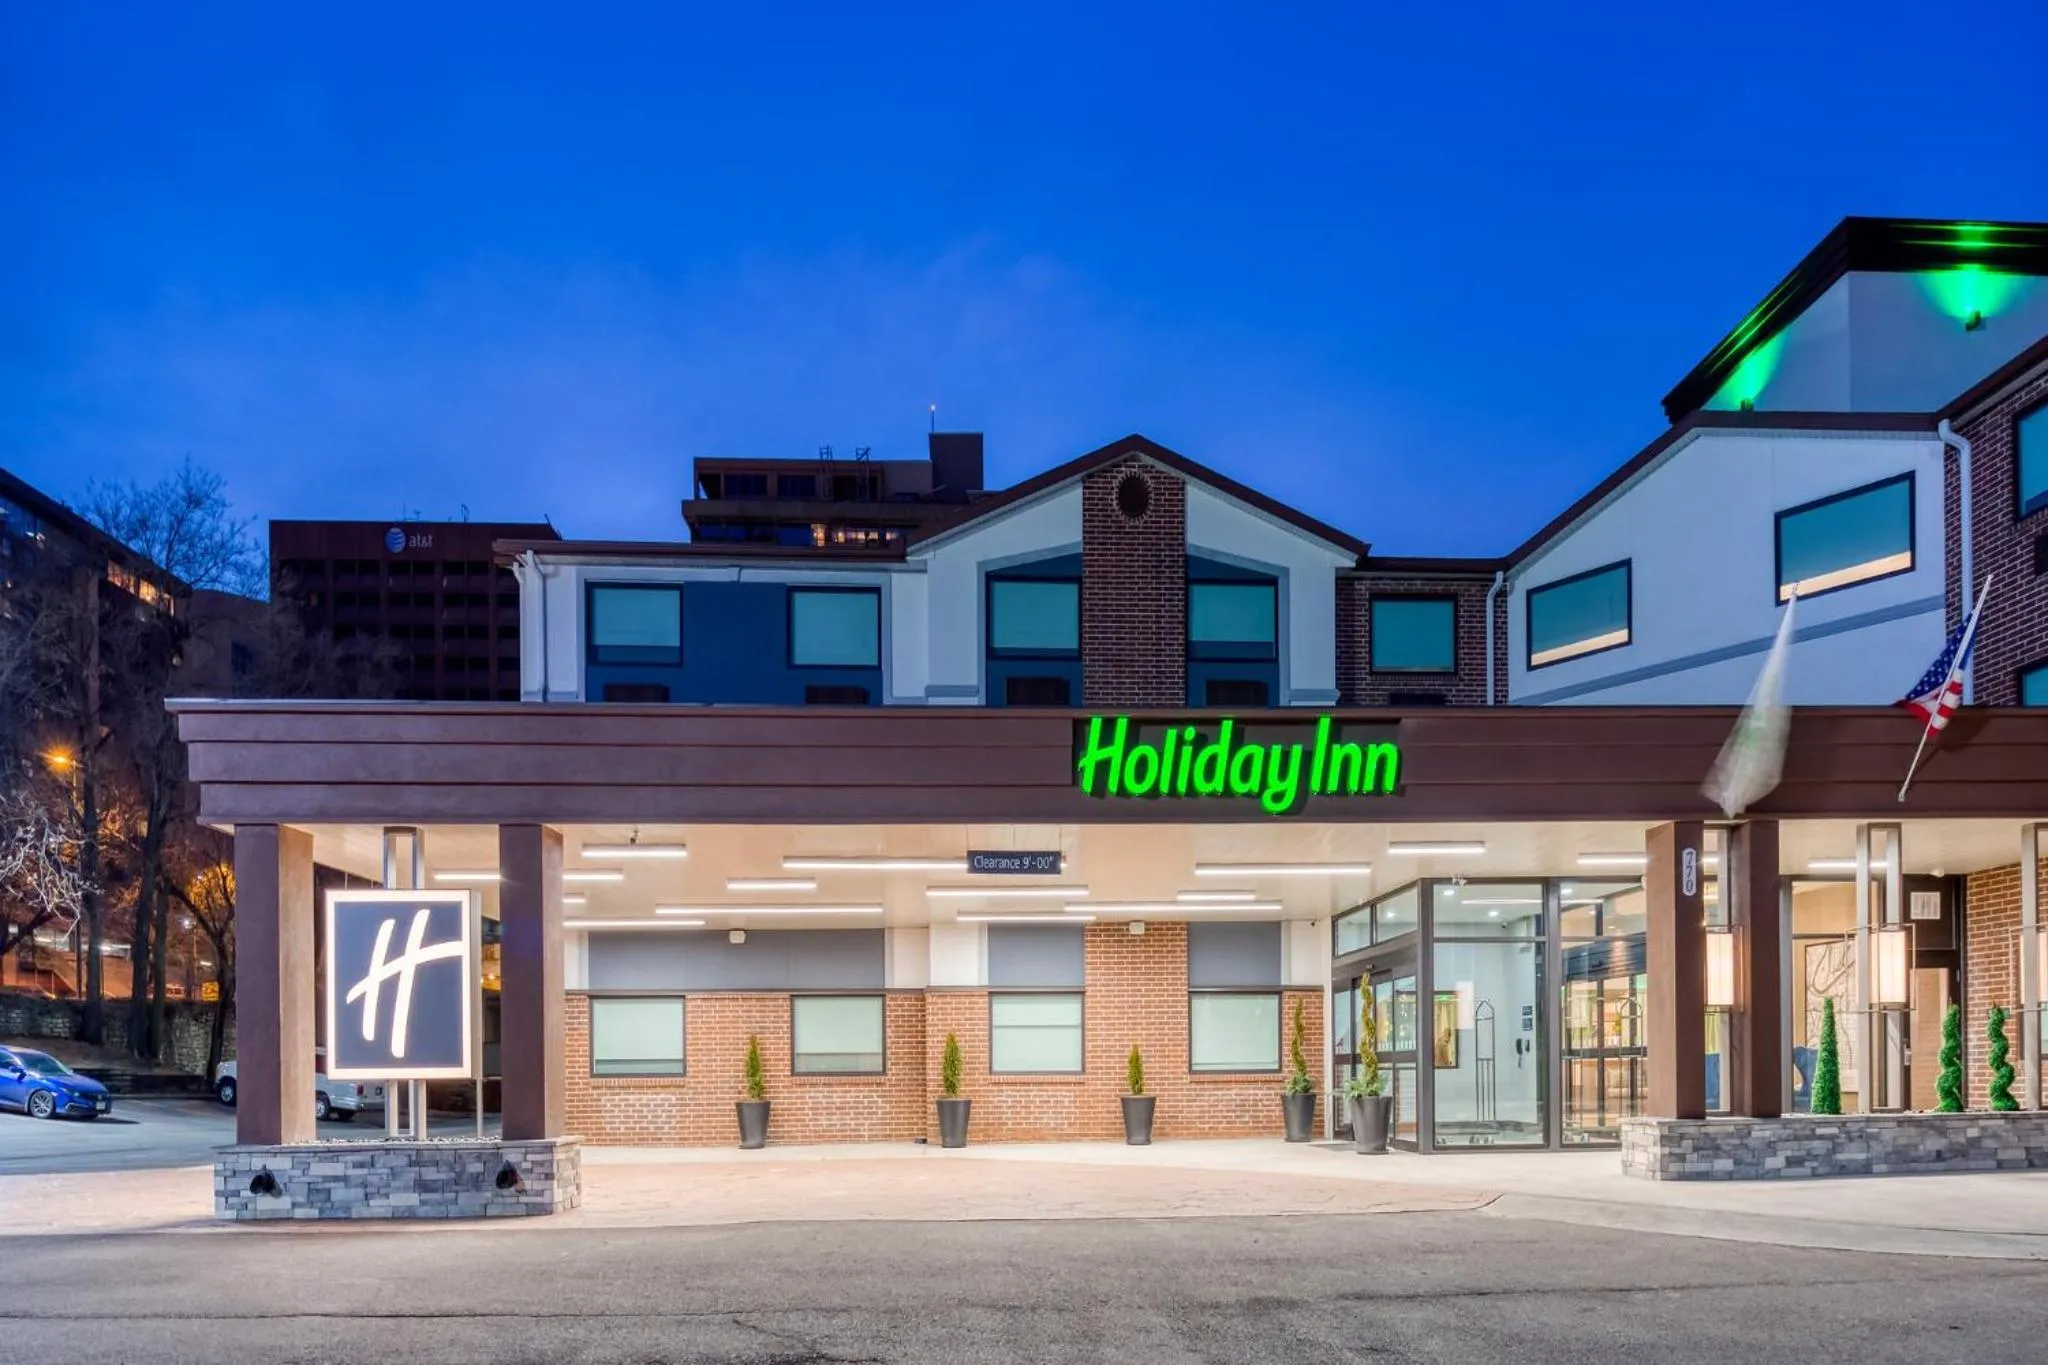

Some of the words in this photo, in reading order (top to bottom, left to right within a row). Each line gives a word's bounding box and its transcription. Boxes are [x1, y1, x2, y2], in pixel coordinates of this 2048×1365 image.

[408, 533, 433, 548] at&t
[1078, 716, 1303, 813] Holiday
[1310, 716, 1398, 795] Inn
[974, 855, 1020, 869] Clearance
[1685, 851, 1694, 892] 770
[346, 908, 464, 1059] H
